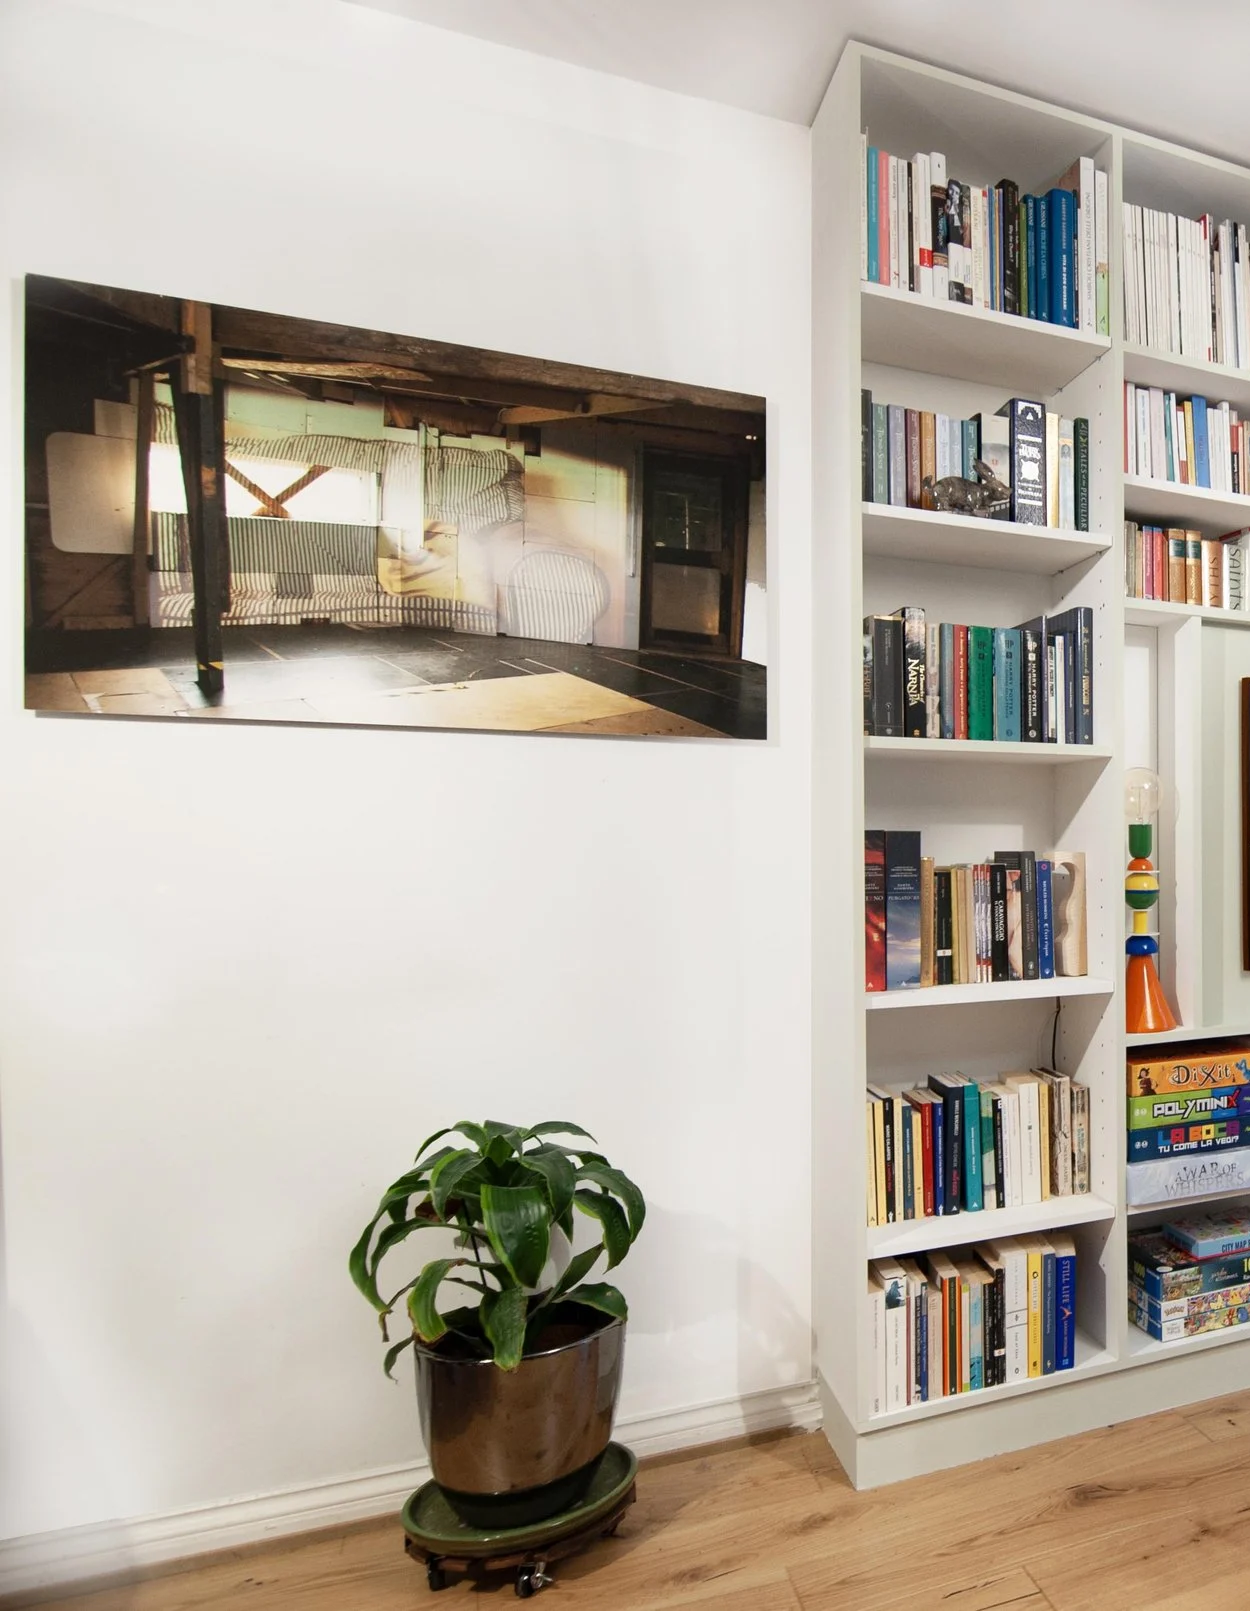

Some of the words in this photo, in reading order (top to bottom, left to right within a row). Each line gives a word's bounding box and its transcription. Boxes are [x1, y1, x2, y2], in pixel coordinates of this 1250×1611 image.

[907, 658, 920, 706] NARNIA
[1153, 1089, 1240, 1119] POLYMINIX
[1158, 1128, 1184, 1146] LA
[1189, 1120, 1240, 1142] BOCA
[1158, 1145, 1170, 1154] TU
[1173, 1141, 1198, 1152] COME
[1200, 1138, 1212, 1148] LA
[1183, 1162, 1220, 1180] WAR
[1222, 1163, 1236, 1176] OF
[1164, 1172, 1245, 1198] WHISPERS
[1222, 1243, 1234, 1253] CITY
[1235, 1240, 1247, 1251] MAP
[1062, 1260, 1070, 1286] STILL
[1062, 1286, 1070, 1304] LIFE
